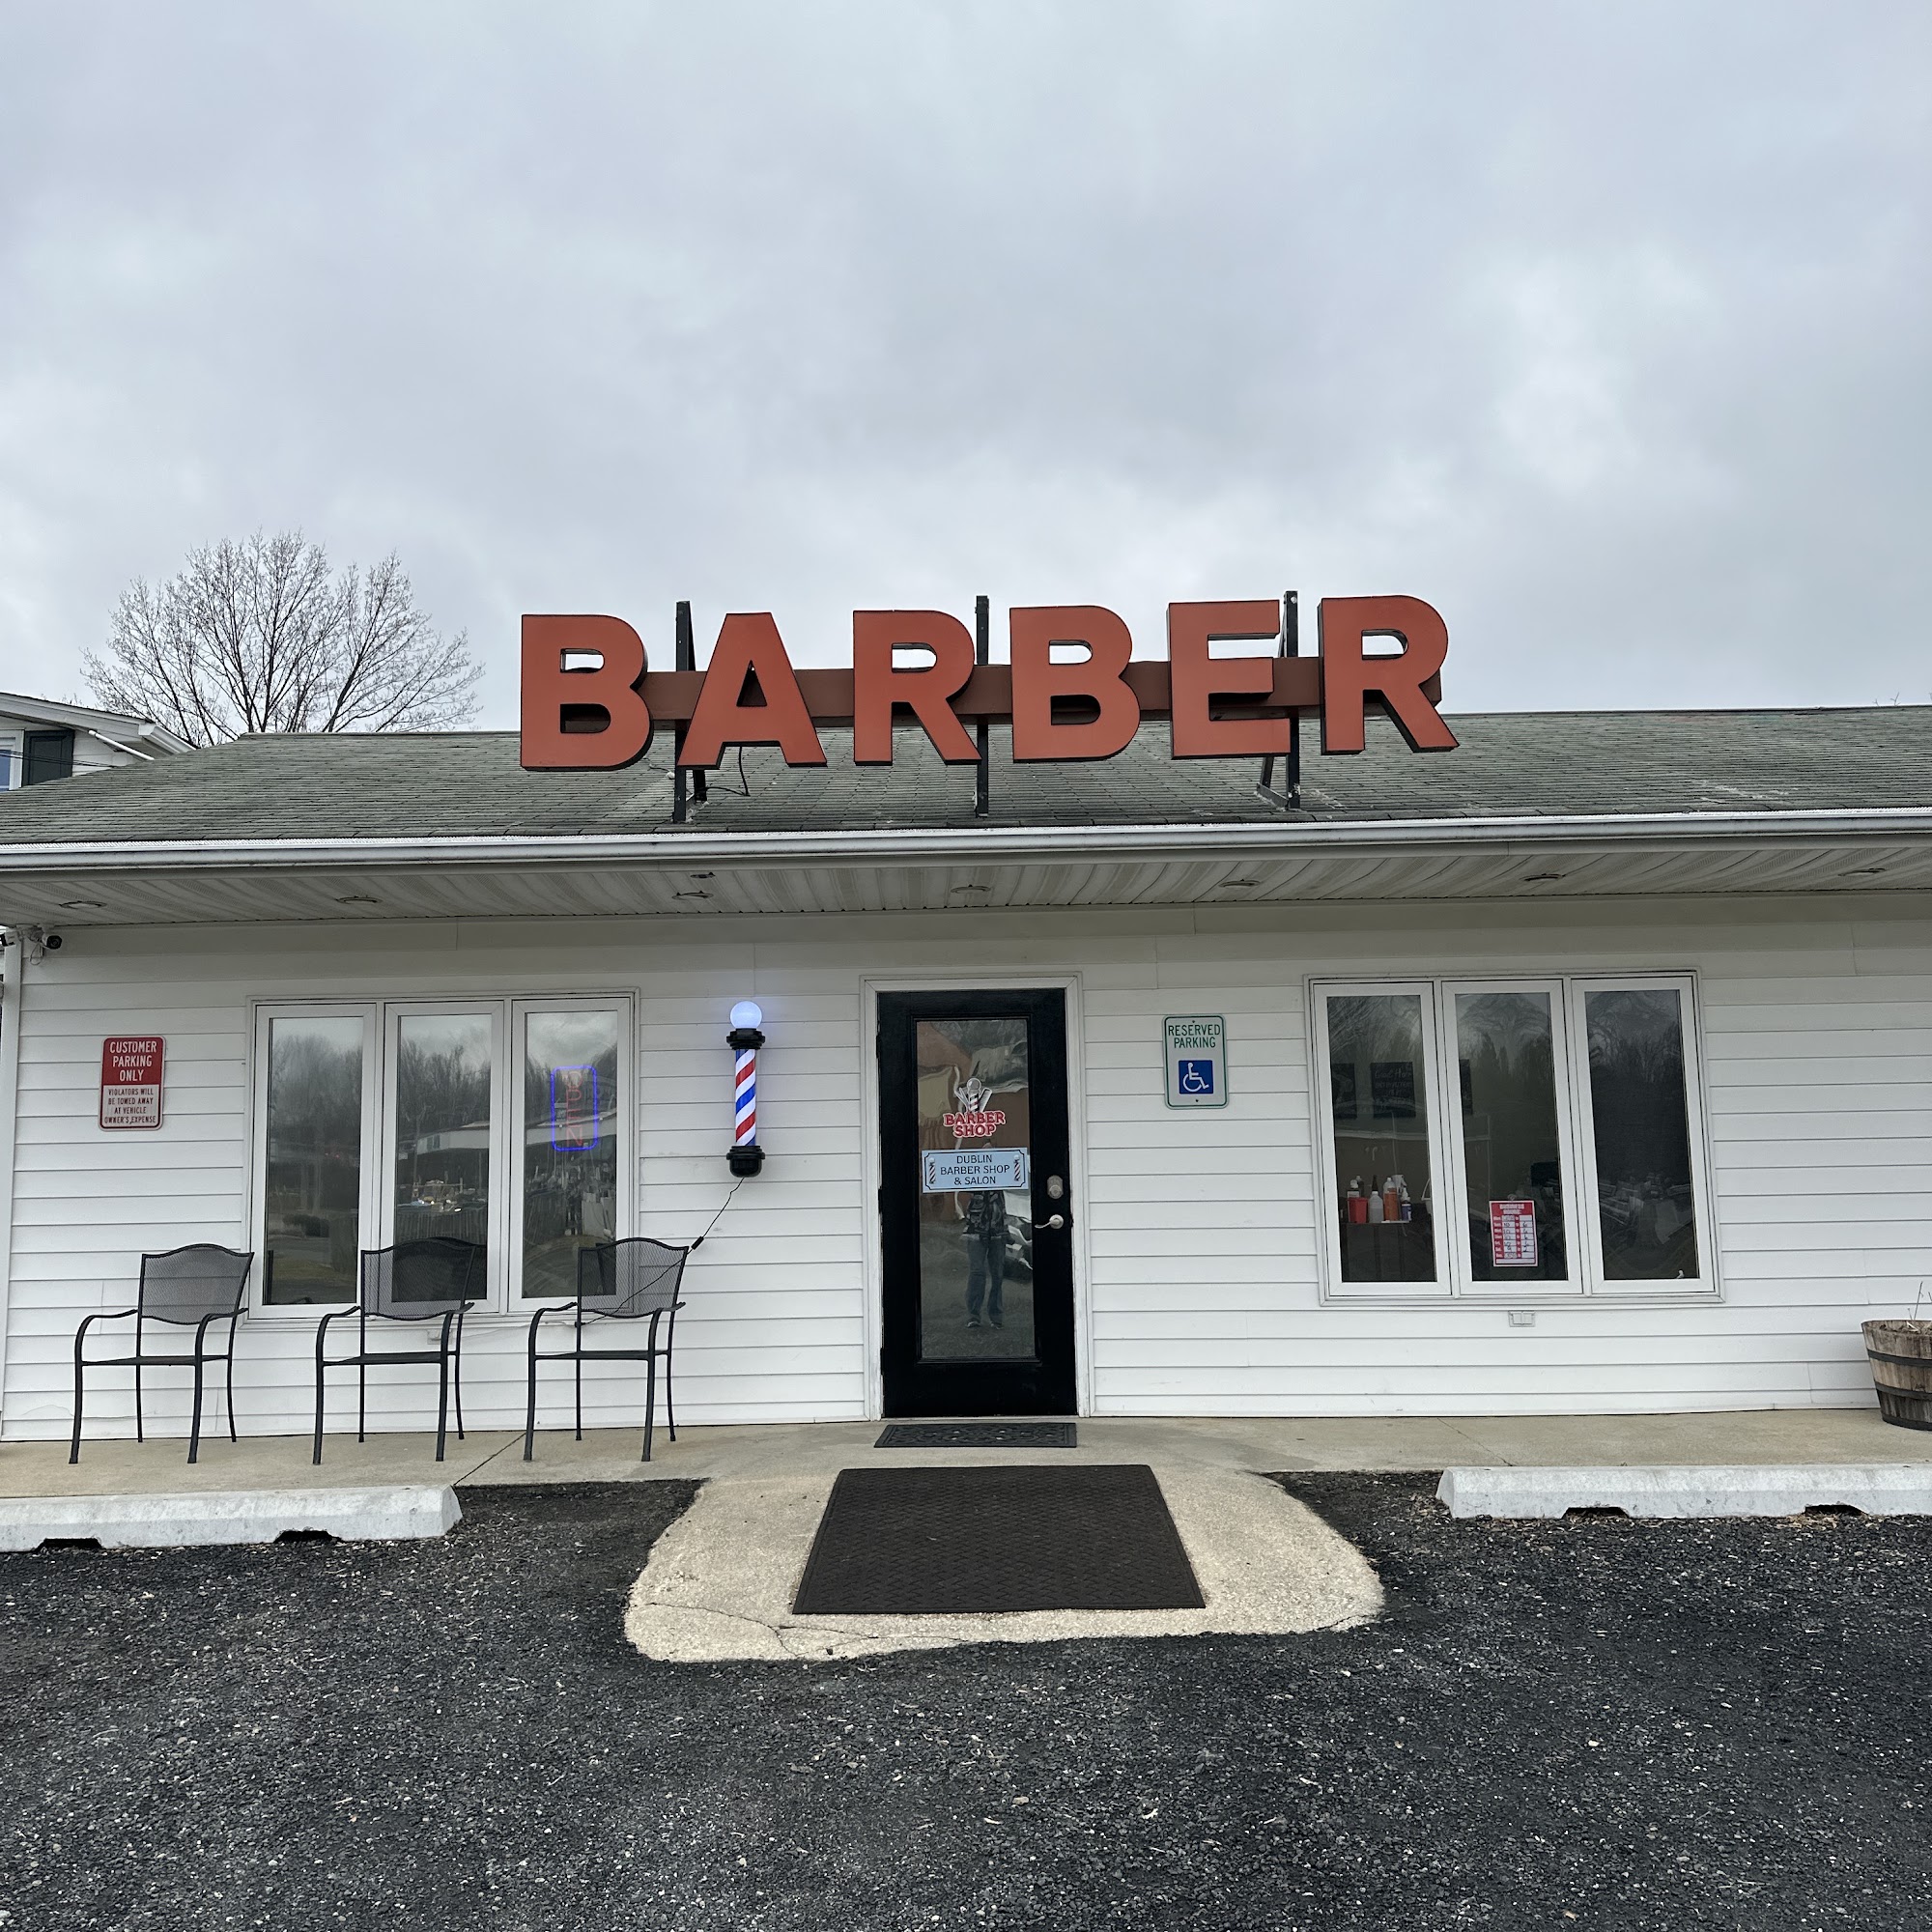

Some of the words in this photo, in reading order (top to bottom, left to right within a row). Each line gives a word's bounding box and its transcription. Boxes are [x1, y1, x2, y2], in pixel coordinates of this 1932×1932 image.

[521, 595, 1460, 771] BARBER
[1168, 1024, 1221, 1036] RESERVED
[109, 1040, 157, 1053] CUSTOMER
[1174, 1037, 1216, 1048] PARKING
[112, 1055, 153, 1067] PARKING
[119, 1069, 144, 1082] ONLY
[565, 1070, 583, 1147] OPEN
[104, 1116, 129, 1124] OWNER'S
[944, 1111, 1006, 1126] BARBER
[953, 1124, 996, 1137] SHOP
[956, 1154, 993, 1164] DUBLIN
[940, 1166, 980, 1176] BARBER
[982, 1165, 1010, 1174] SHOP
[953, 1177, 962, 1185] &
[964, 1176, 996, 1185] SALON
